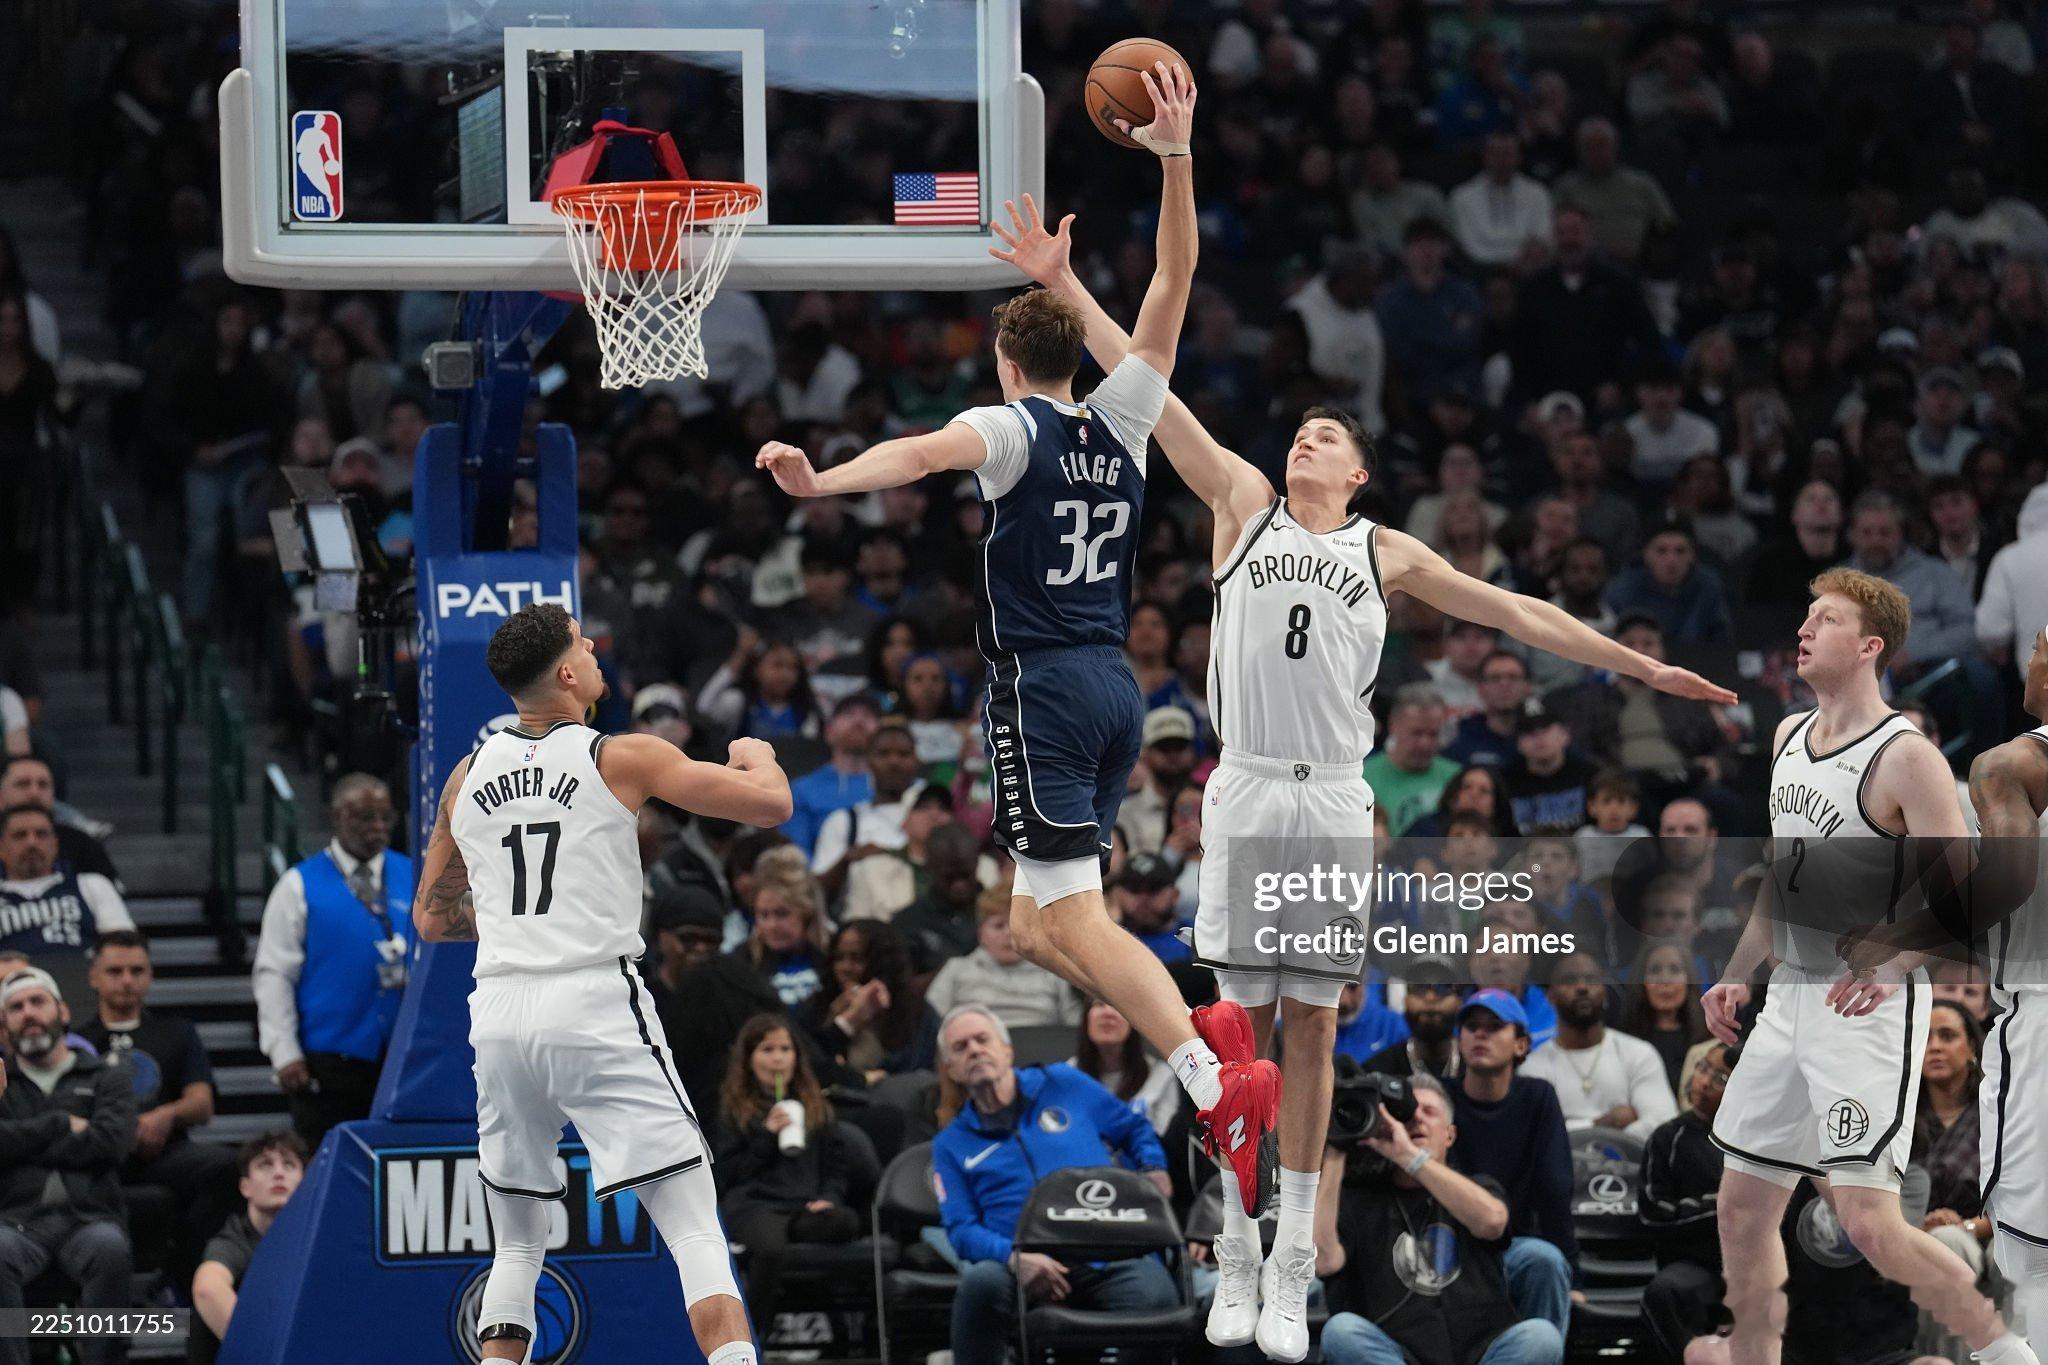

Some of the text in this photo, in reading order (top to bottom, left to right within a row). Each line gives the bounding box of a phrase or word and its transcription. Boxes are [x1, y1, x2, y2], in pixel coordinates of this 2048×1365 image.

[301, 195, 325, 214] NBA
[1059, 451, 1122, 486] FLAGG
[1046, 500, 1131, 585] 32
[437, 581, 574, 618] PATH
[1248, 553, 1369, 609] BROOKLYN
[1285, 604, 1311, 659] 8
[472, 767, 580, 816] PORTER JR.
[996, 725, 1029, 851] MAVERICKS
[1770, 783, 1845, 841] BROOKLYN
[501, 821, 562, 916] 17
[1787, 837, 1806, 894] 2
[1838, 1106, 1852, 1139] B
[1046, 1206, 1148, 1222] LEXUS
